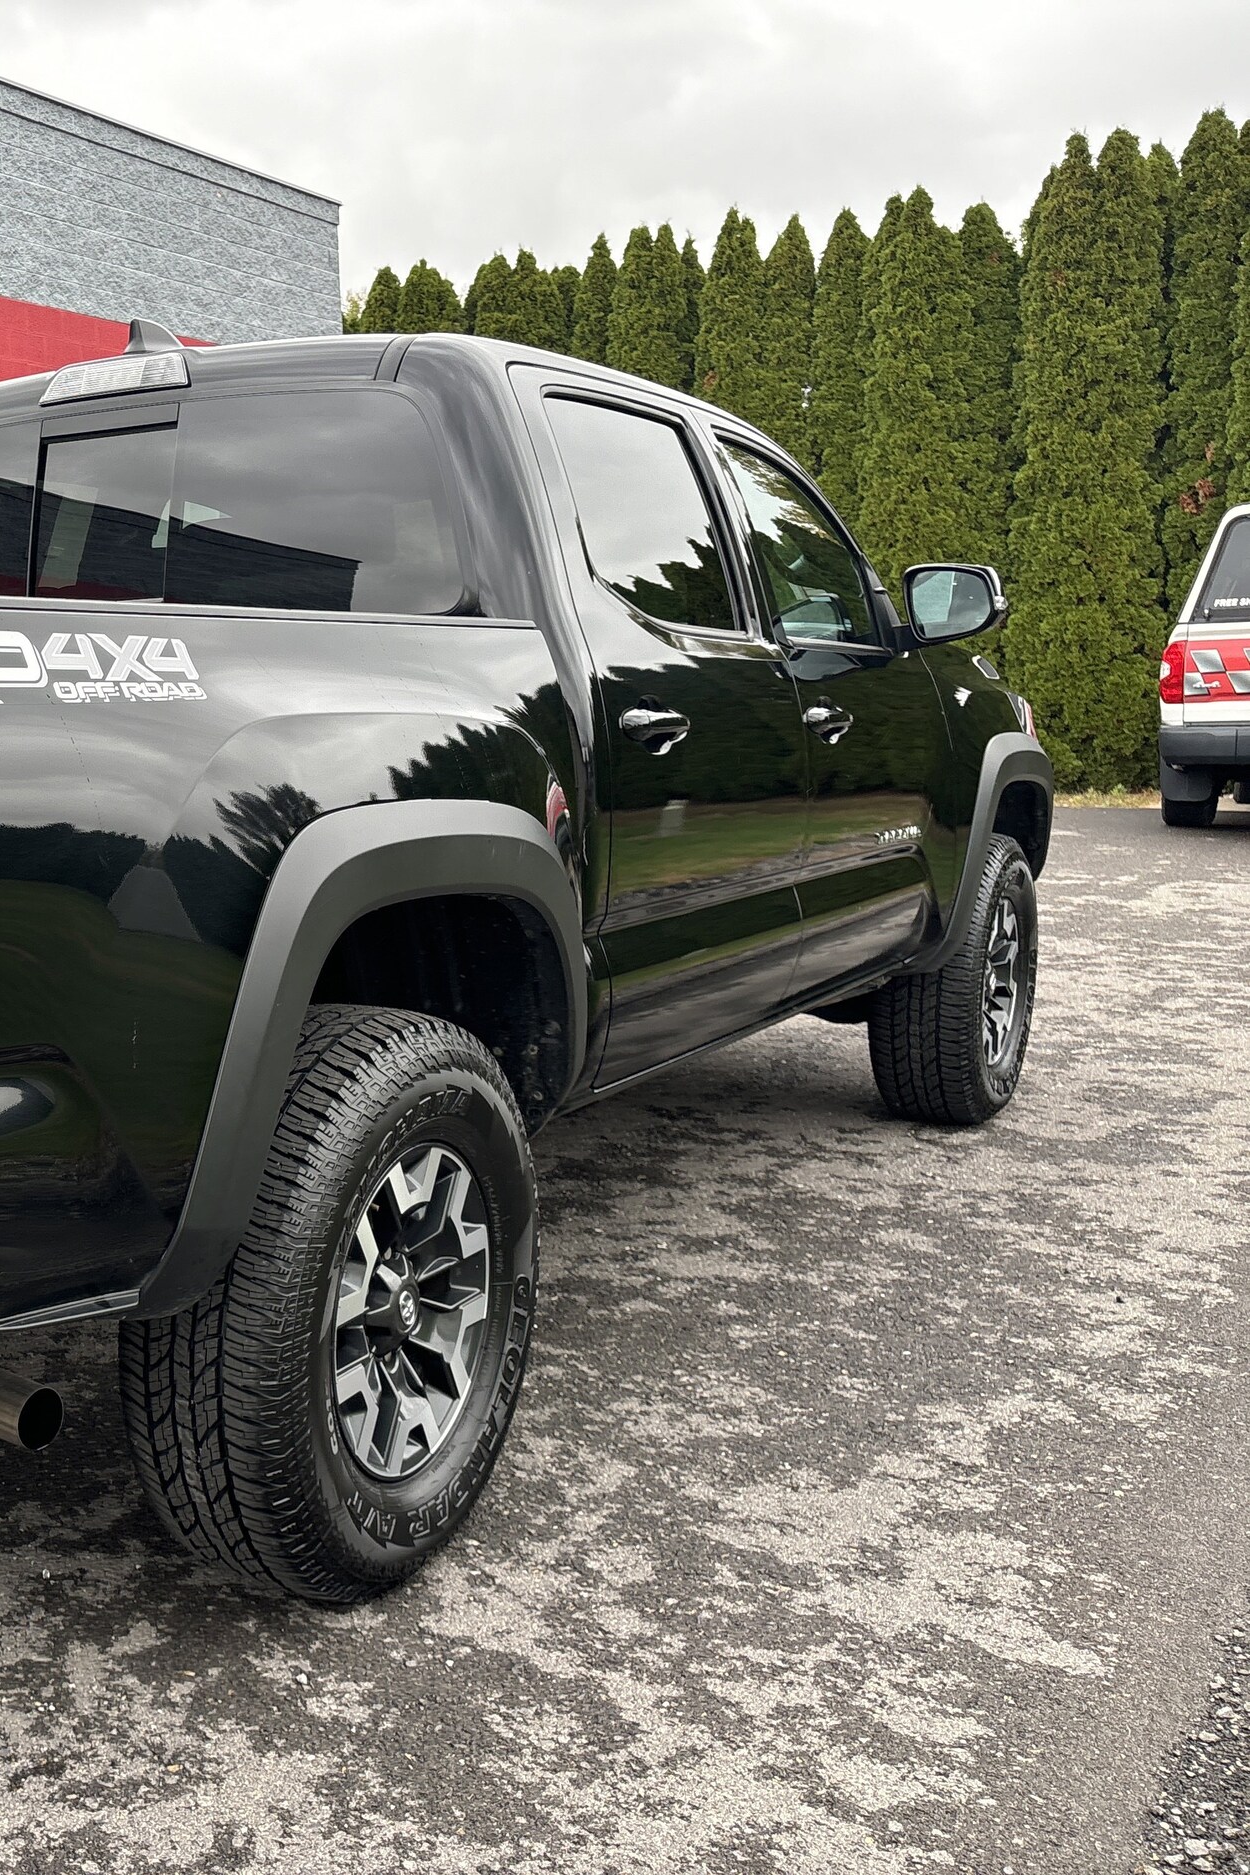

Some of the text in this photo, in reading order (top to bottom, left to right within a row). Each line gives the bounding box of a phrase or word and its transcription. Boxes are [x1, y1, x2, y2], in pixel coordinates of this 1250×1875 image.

[53, 681, 207, 703] OFF ROAD
[408, 1274, 530, 1537] GEOLANDAR
